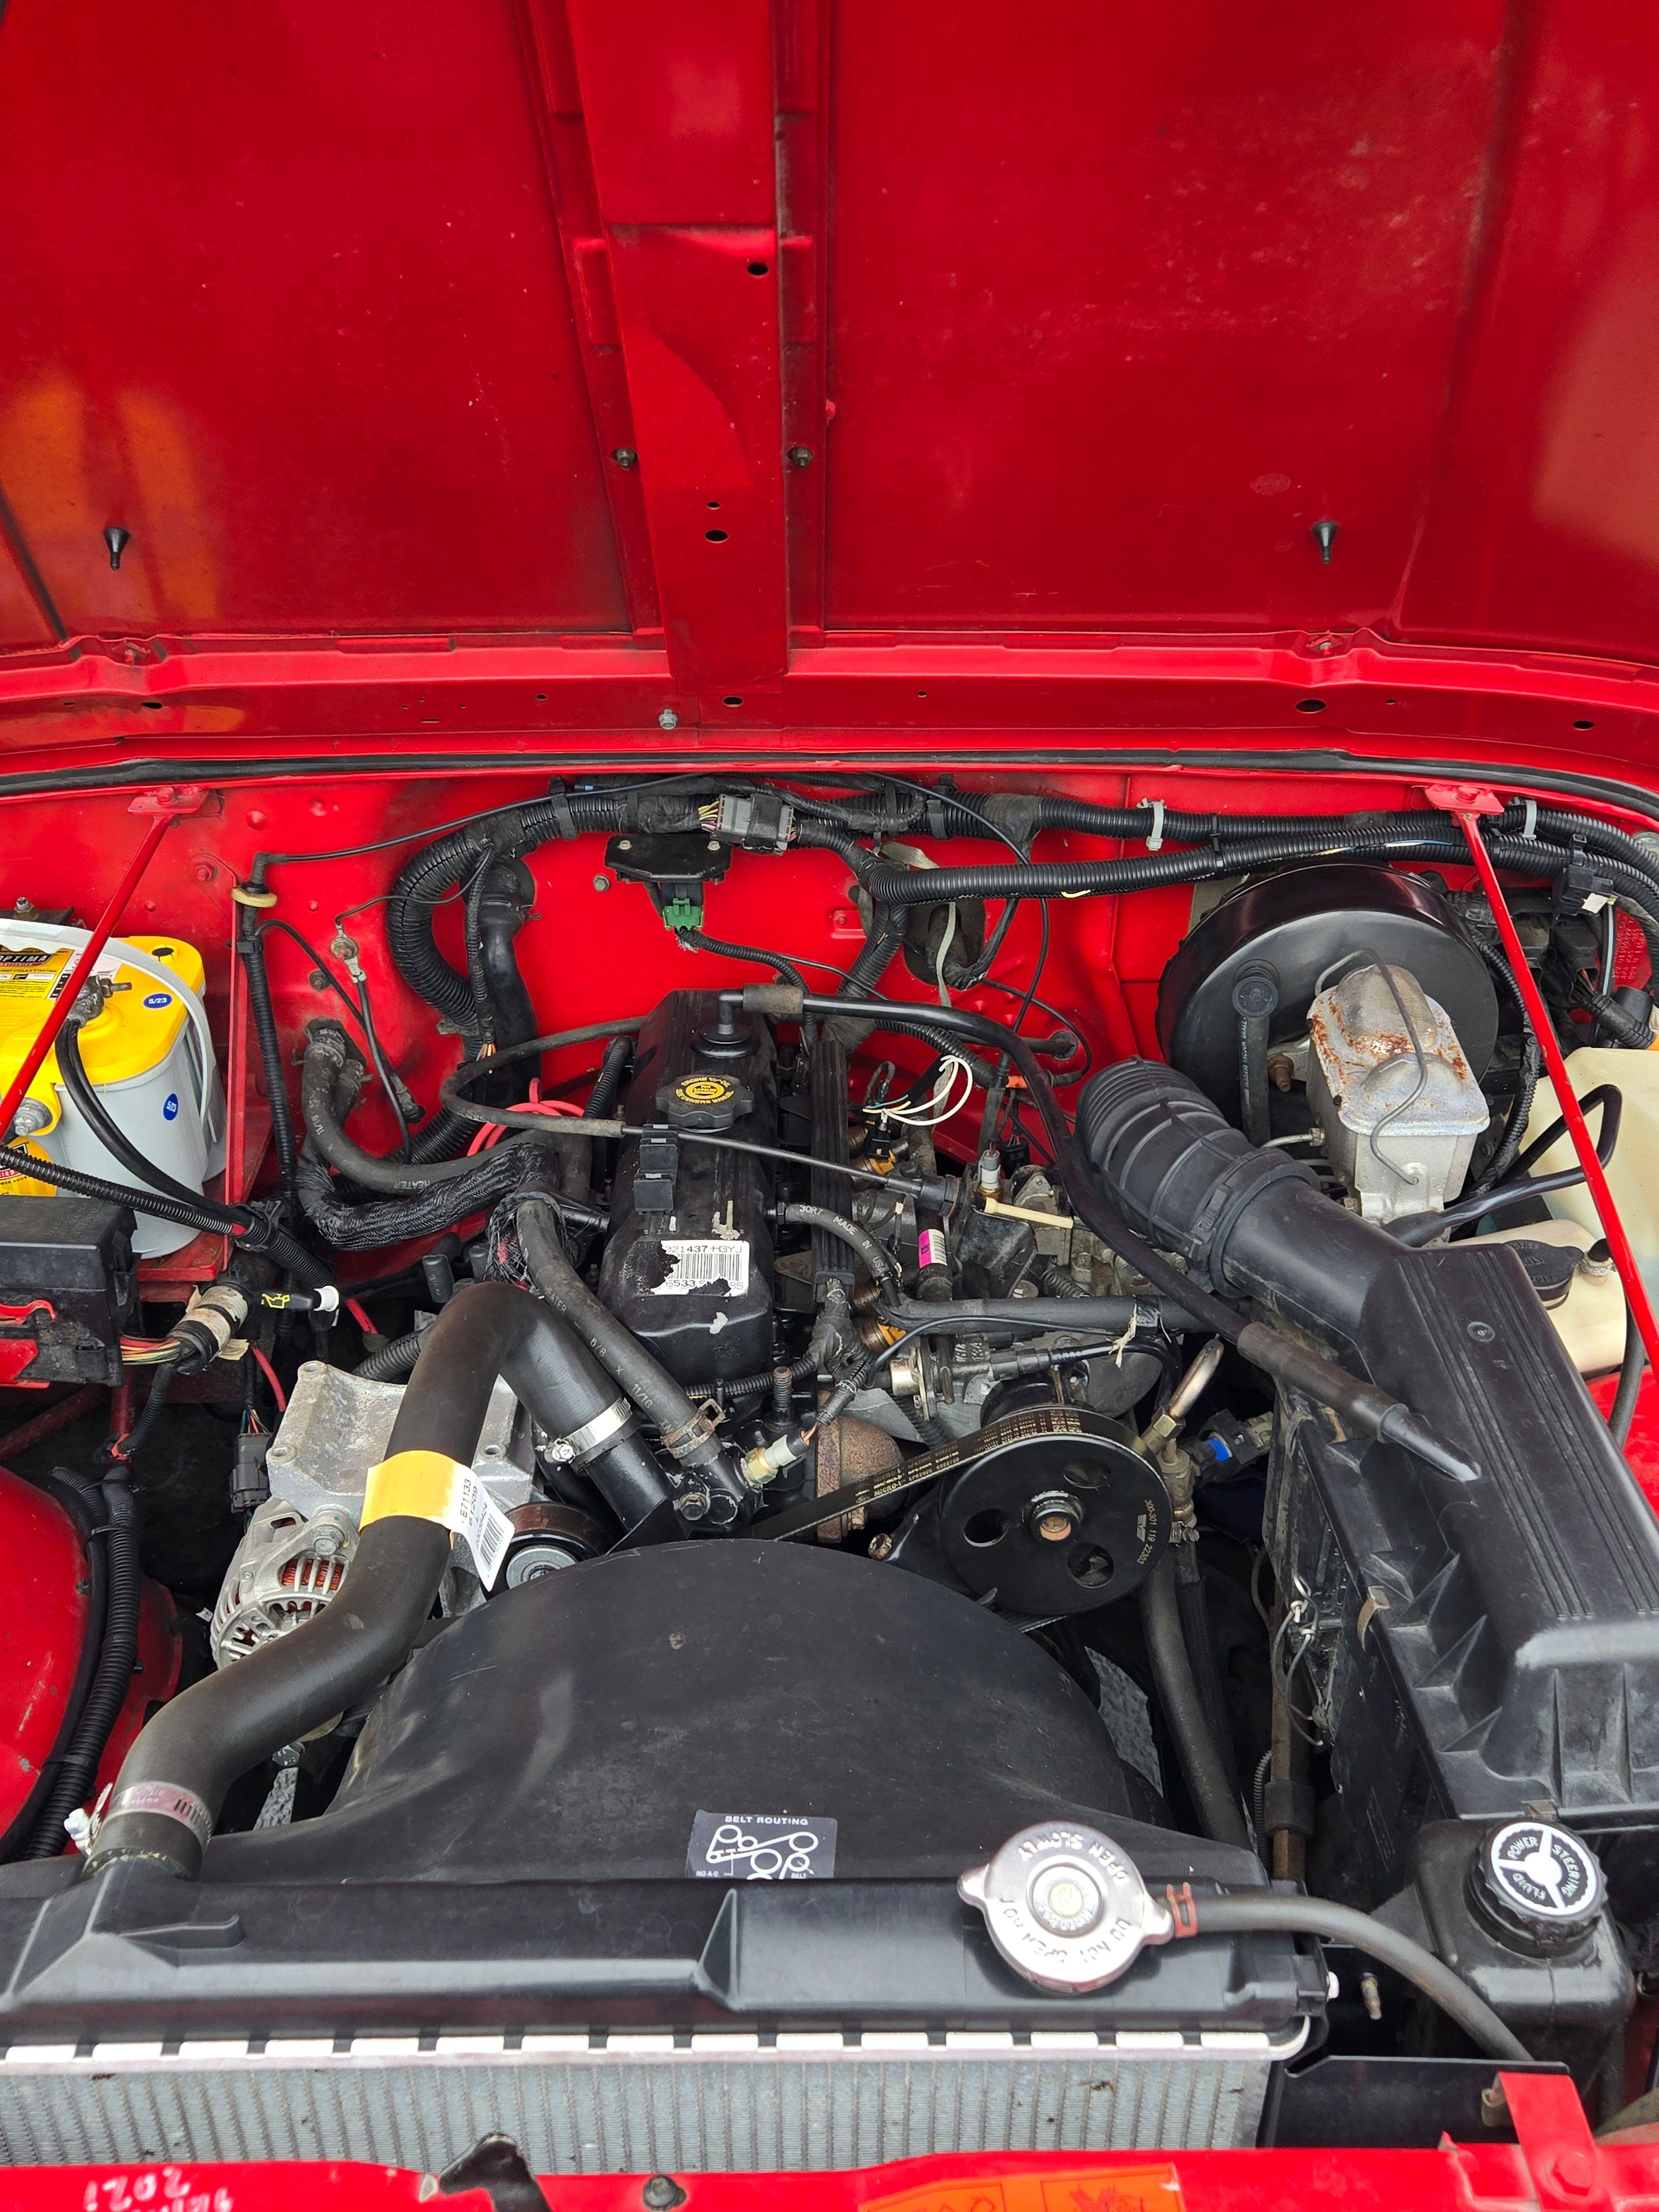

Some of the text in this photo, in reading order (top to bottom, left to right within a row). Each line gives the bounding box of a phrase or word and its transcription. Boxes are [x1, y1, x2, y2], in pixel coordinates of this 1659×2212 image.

[166, 1100, 176, 1113] 5/23
[833, 1216, 858, 1235] MADE
[862, 1240, 872, 1250] IN
[872, 1256, 886, 1276] USA
[544, 1286, 567, 1315] HEATER
[632, 1384, 653, 1409] 11/16
[460, 1479, 471, 1518] E71133
[1137, 1499, 1157, 1564] 300-301 119 22303
[757, 1817, 809, 1825] ROUTING
[1018, 1831, 1130, 1886] OPEN SLOWLY
[1507, 1836, 1580, 1901] POWER STEERING FLUID
